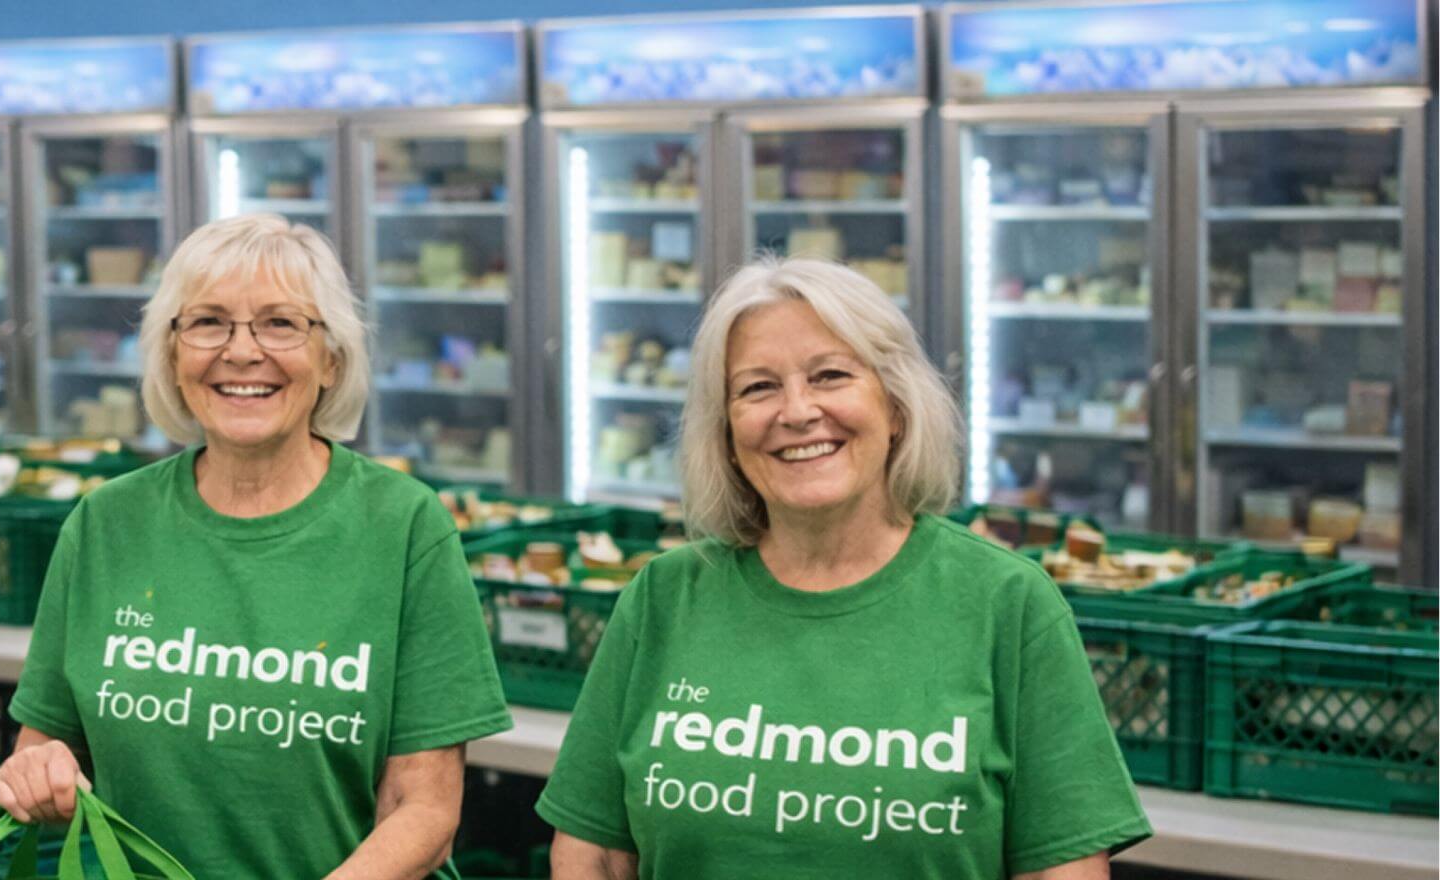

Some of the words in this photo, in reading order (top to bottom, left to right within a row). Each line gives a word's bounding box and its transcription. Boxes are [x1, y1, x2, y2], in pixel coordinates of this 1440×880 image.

[114, 603, 155, 629] the
[103, 626, 372, 693] redmond
[667, 677, 711, 704] the
[96, 678, 193, 727] food
[207, 697, 367, 749] project
[650, 702, 969, 774] redmond
[644, 761, 757, 817] food
[775, 785, 968, 841] project
